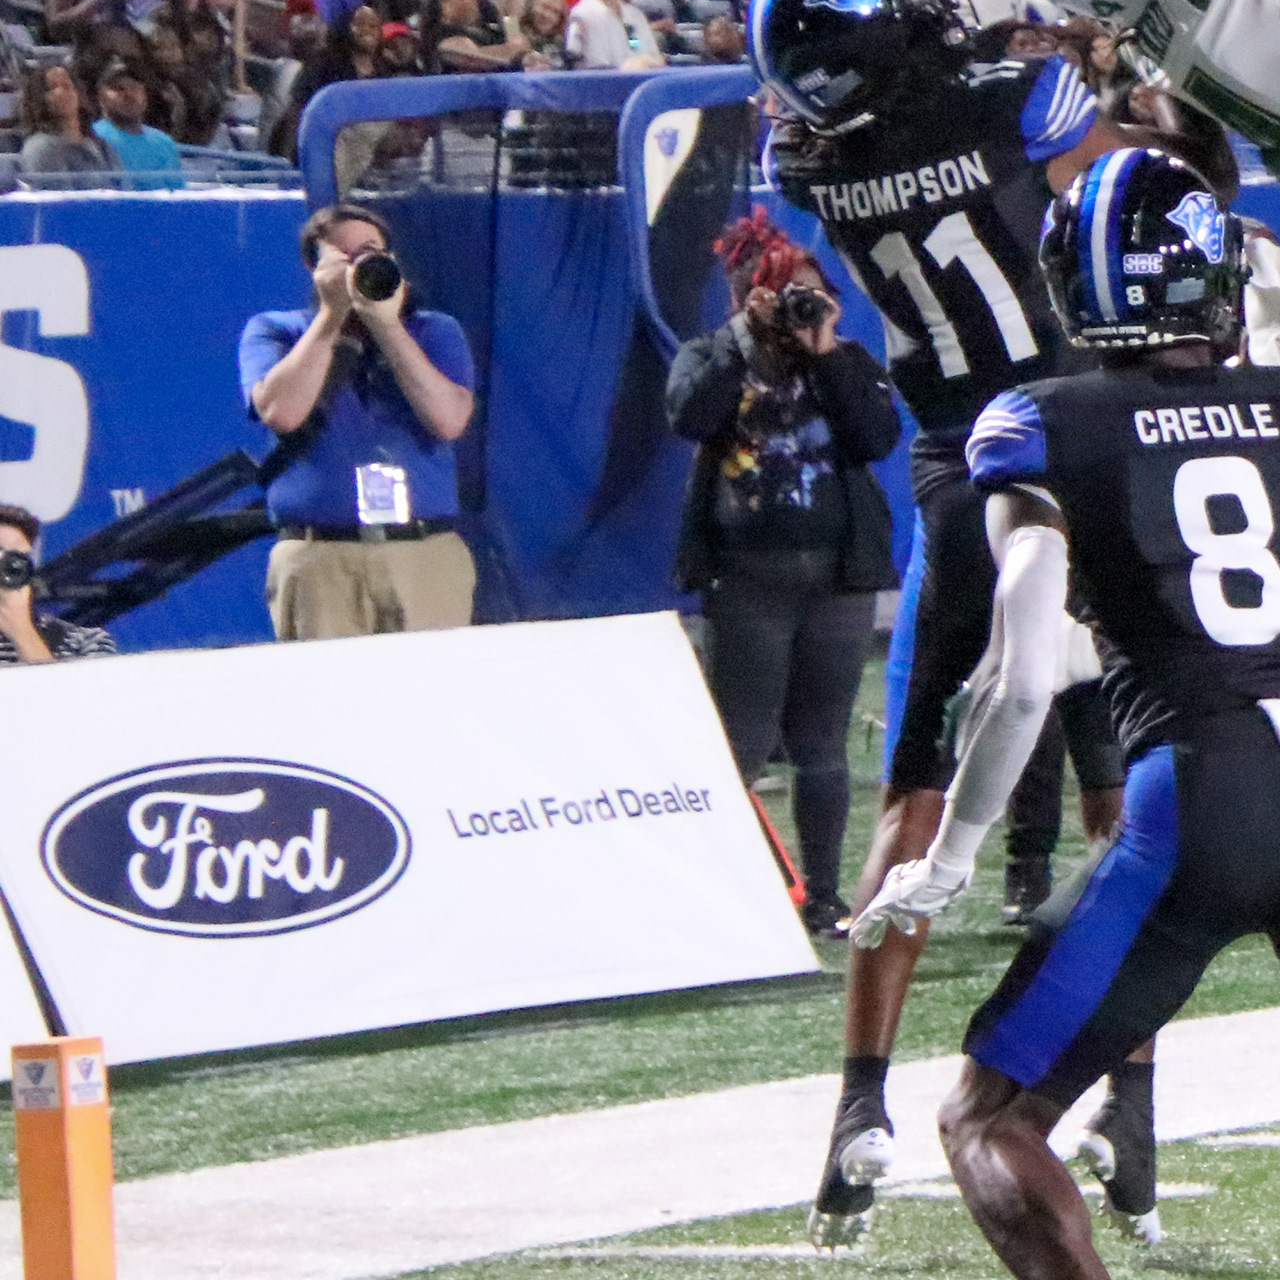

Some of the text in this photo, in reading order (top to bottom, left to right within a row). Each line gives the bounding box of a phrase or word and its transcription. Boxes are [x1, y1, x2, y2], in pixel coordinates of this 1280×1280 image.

[809, 150, 992, 221] THOMPSON
[1122, 252, 1163, 274] SBC
[868, 210, 1040, 379] 11
[1125, 286, 1145, 306] 8
[1134, 402, 1280, 445] CREDLE
[446, 781, 713, 840] Local Ford Dealer
[126, 787, 344, 910] Ford
